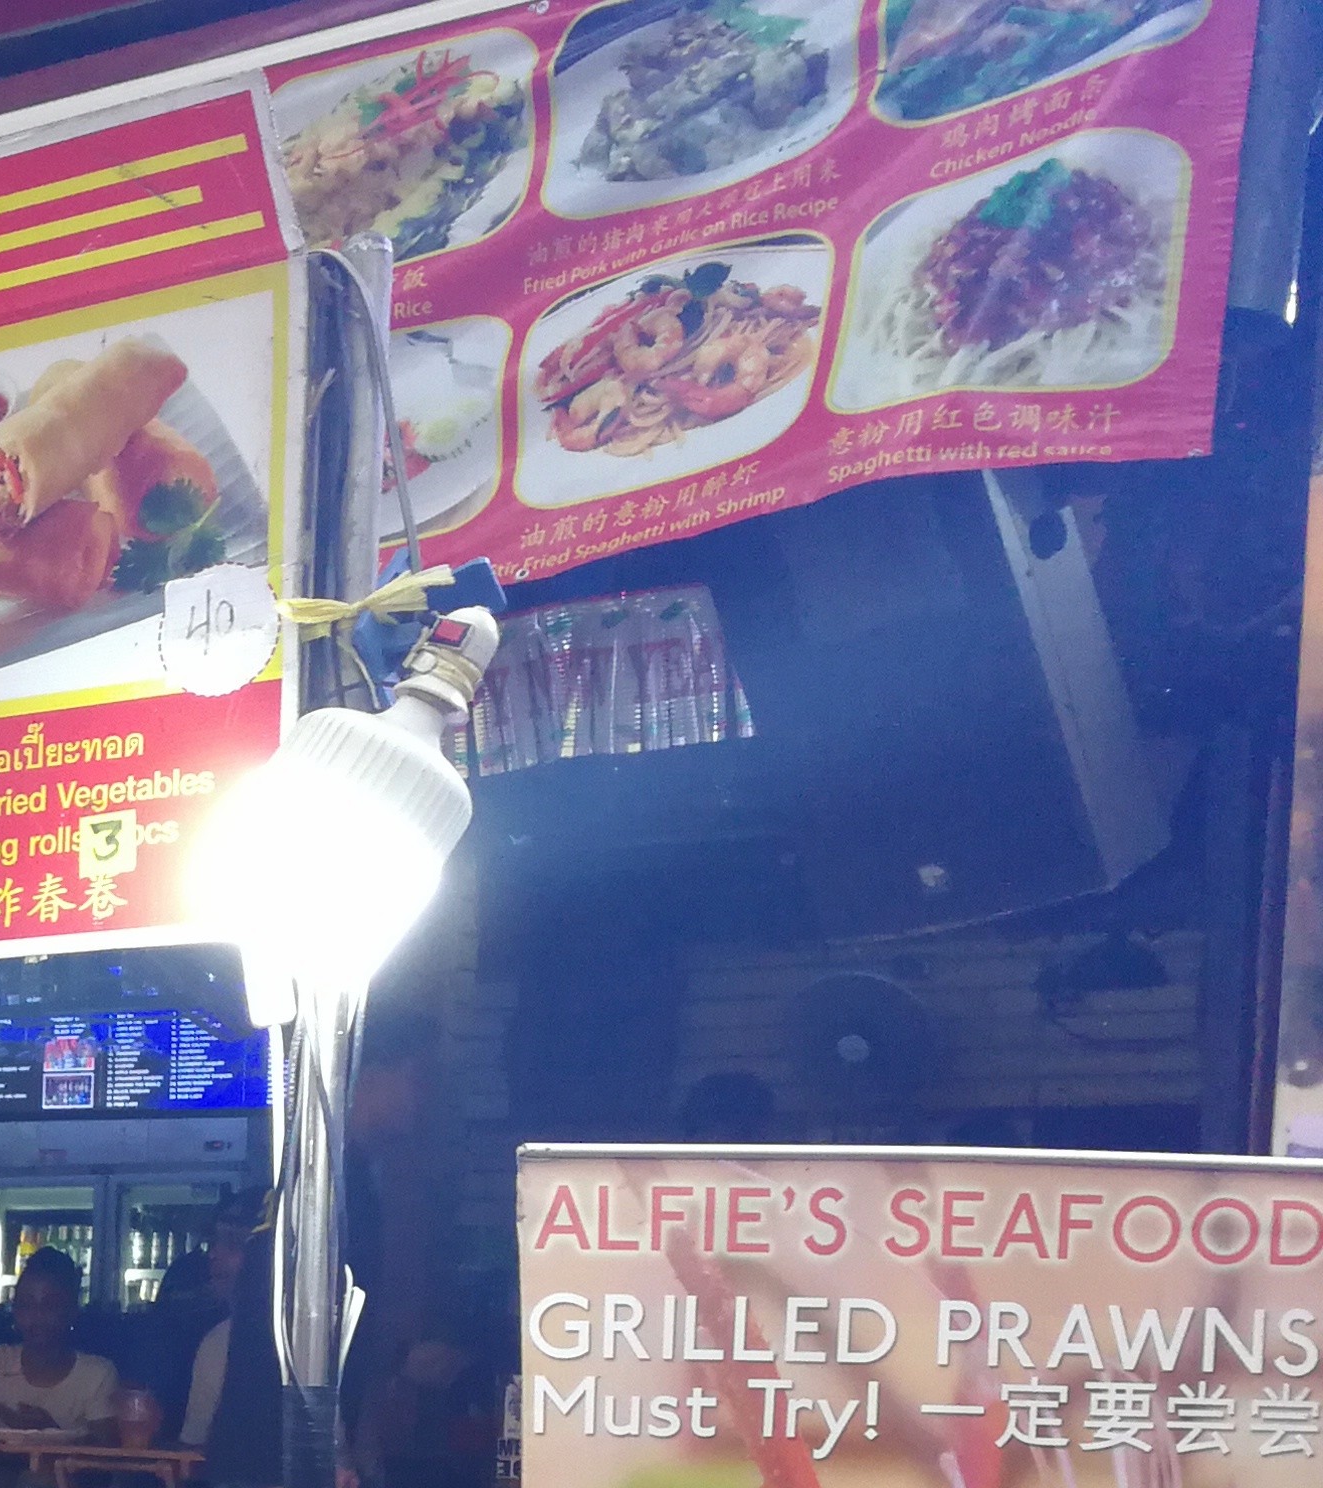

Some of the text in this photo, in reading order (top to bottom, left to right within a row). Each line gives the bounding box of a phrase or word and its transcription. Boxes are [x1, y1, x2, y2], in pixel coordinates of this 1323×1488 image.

[930, 141, 1013, 179] Chicken
[523, 274, 566, 295] Fried
[570, 262, 606, 281] Pork
[730, 209, 768, 229] Rice
[773, 197, 838, 221] Recipe
[394, 300, 433, 319] Rice
[828, 443, 932, 483] Spaghetti
[938, 439, 991, 461] with
[997, 441, 1037, 459] red
[573, 522, 666, 561] Spaghetti
[669, 507, 711, 534] with
[715, 485, 786, 518] Shrimp
[185, 588, 236, 657] 40
[57, 767, 215, 811] Vegetables
[29, 825, 81, 857] rolls
[90, 820, 123, 861] 3
[534, 1184, 1323, 1266] ALFIE'S SEAFOOD
[528, 1292, 1322, 1379] GRILLED PRAWNS
[532, 1373, 880, 1461] Must Try!
[920, 1375, 1322, 1458] 一定要尝尝
